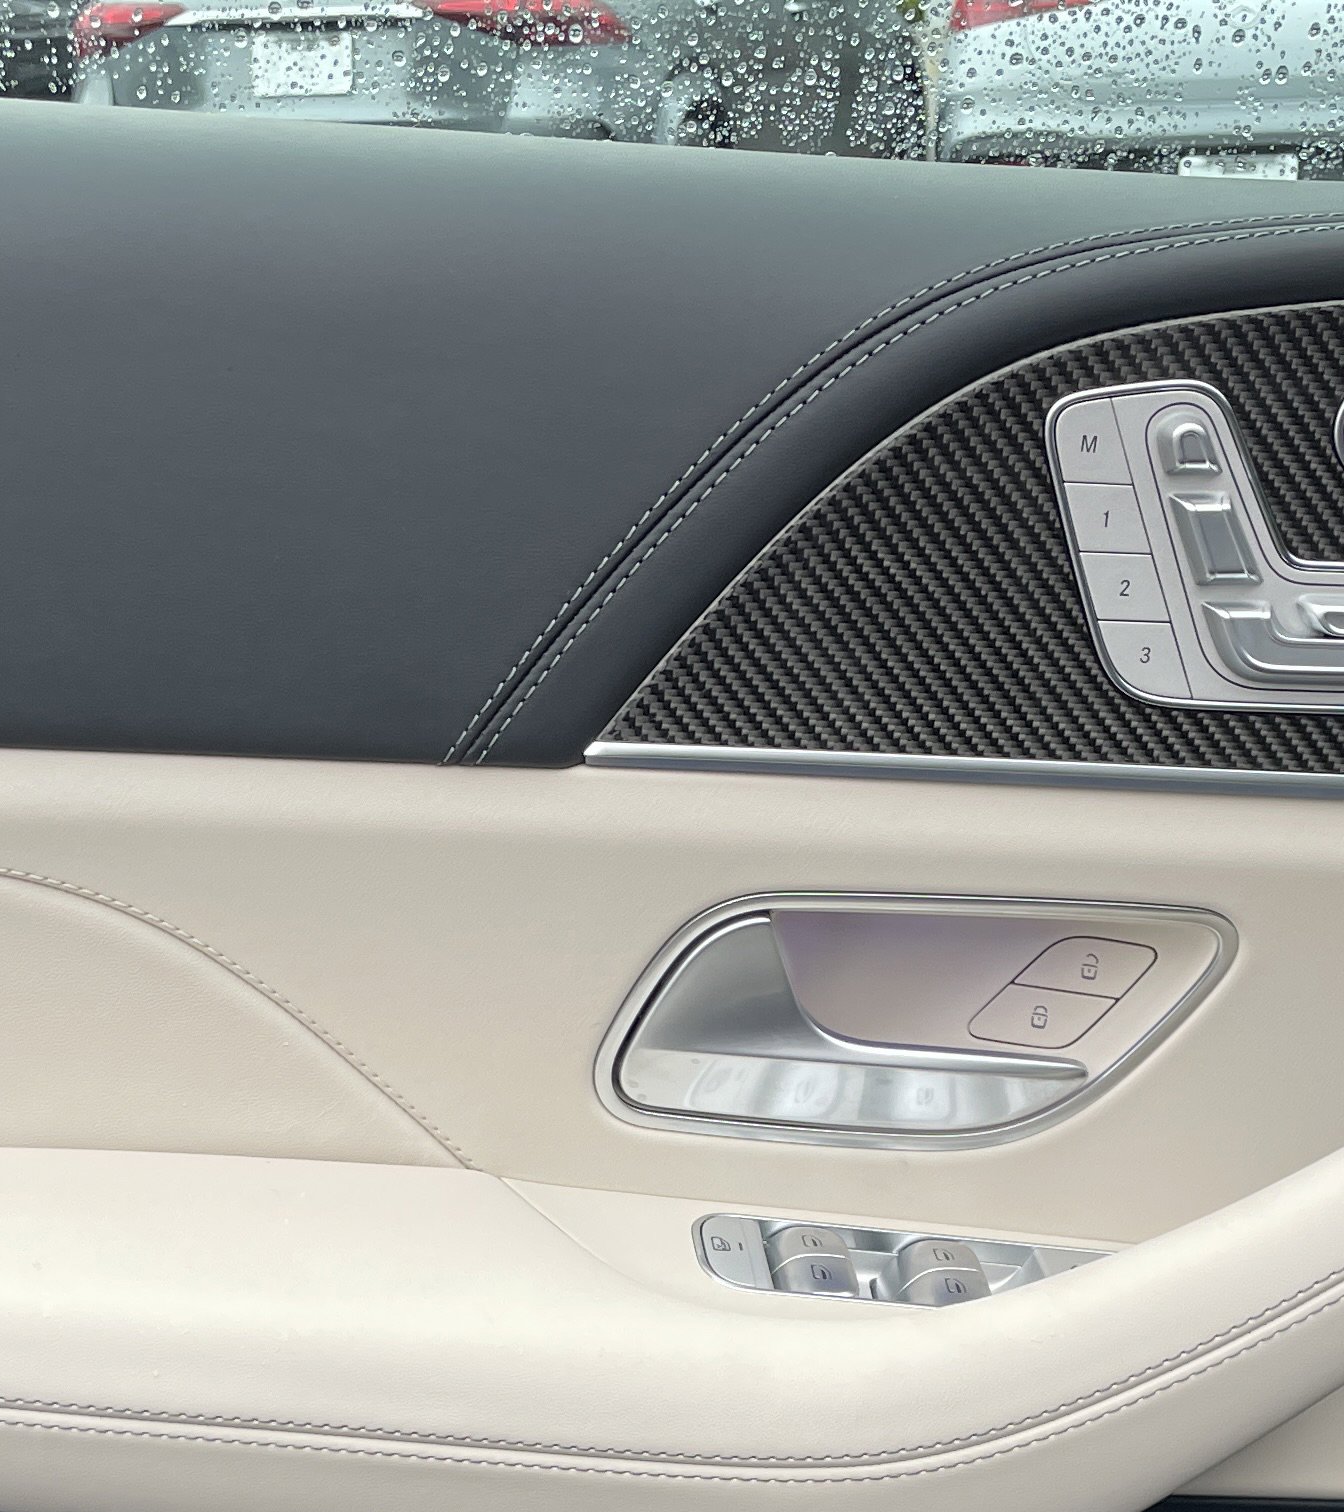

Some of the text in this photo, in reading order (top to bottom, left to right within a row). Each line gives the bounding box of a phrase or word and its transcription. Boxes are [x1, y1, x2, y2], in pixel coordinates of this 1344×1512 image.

[1080, 434, 1098, 454] M
[1103, 511, 1111, 528] 1
[1119, 580, 1131, 597] 2
[1140, 647, 1152, 664] 3
